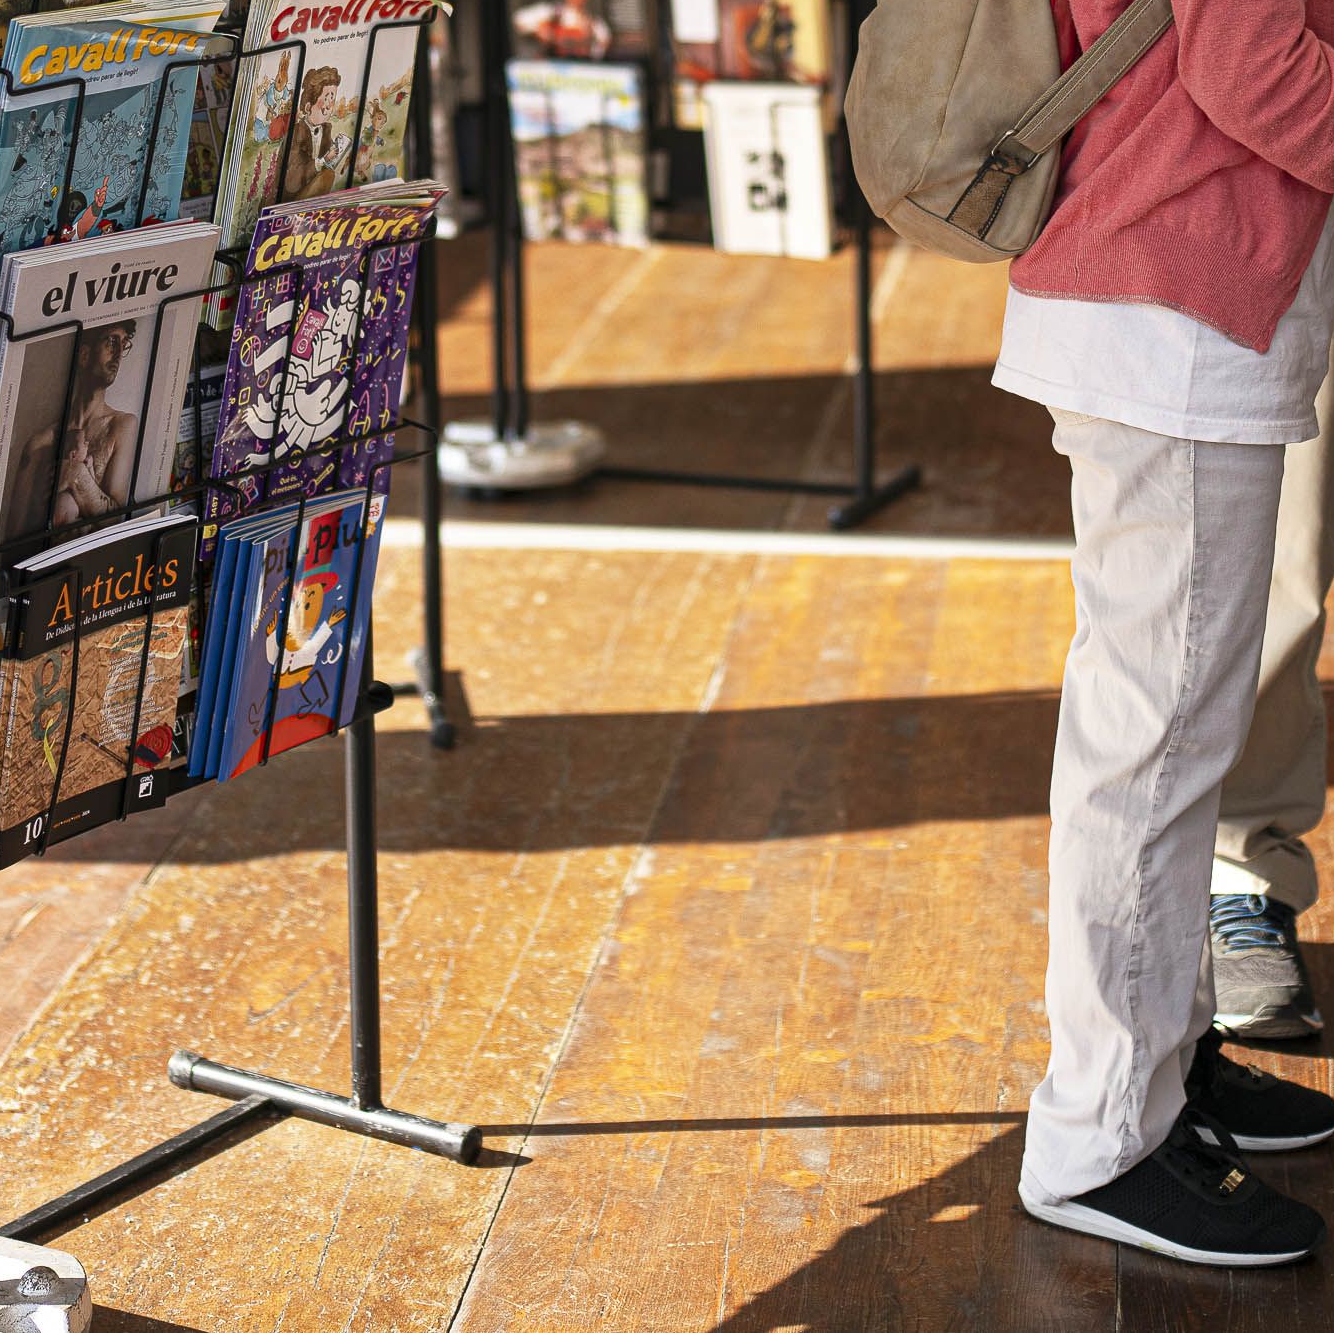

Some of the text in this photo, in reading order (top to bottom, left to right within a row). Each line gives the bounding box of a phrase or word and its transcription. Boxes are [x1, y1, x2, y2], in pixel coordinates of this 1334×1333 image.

[313, 32, 356, 46] No podreu parar de
[19, 27, 207, 86] Cavall Fort
[101, 72, 115, 84] parar
[115, 70, 124, 79] de
[255, 215, 420, 272] Cavall Fort
[40, 262, 179, 318] el viure
[300, 324, 316, 339] Fort
[305, 312, 326, 330] Cavall
[45, 598, 143, 641] De de la Llengua de la
